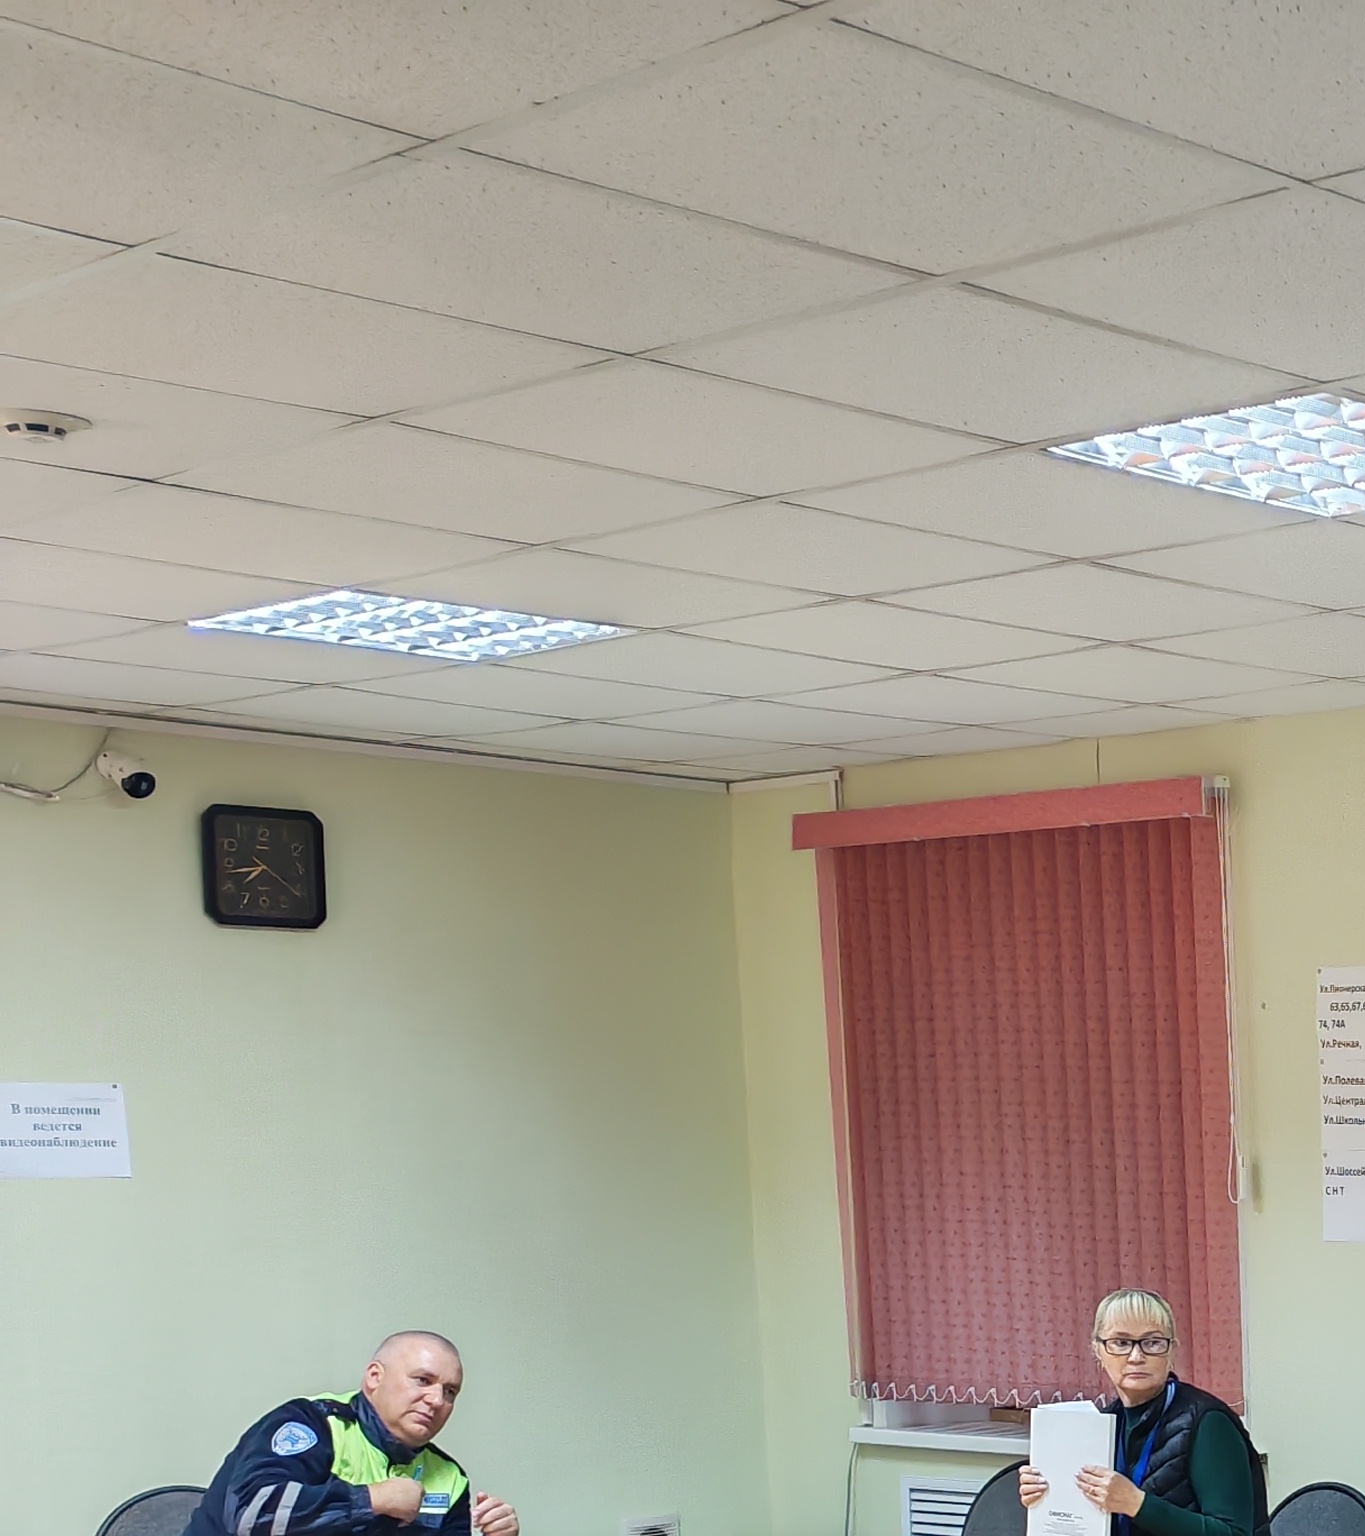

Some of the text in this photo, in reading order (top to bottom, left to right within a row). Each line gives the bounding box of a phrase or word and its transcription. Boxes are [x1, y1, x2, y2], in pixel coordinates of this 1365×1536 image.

[10, 1103, 101, 1116] В помещении
[32, 1122, 82, 1132] ведется
[0, 1137, 118, 1149] видеонаблюдение
